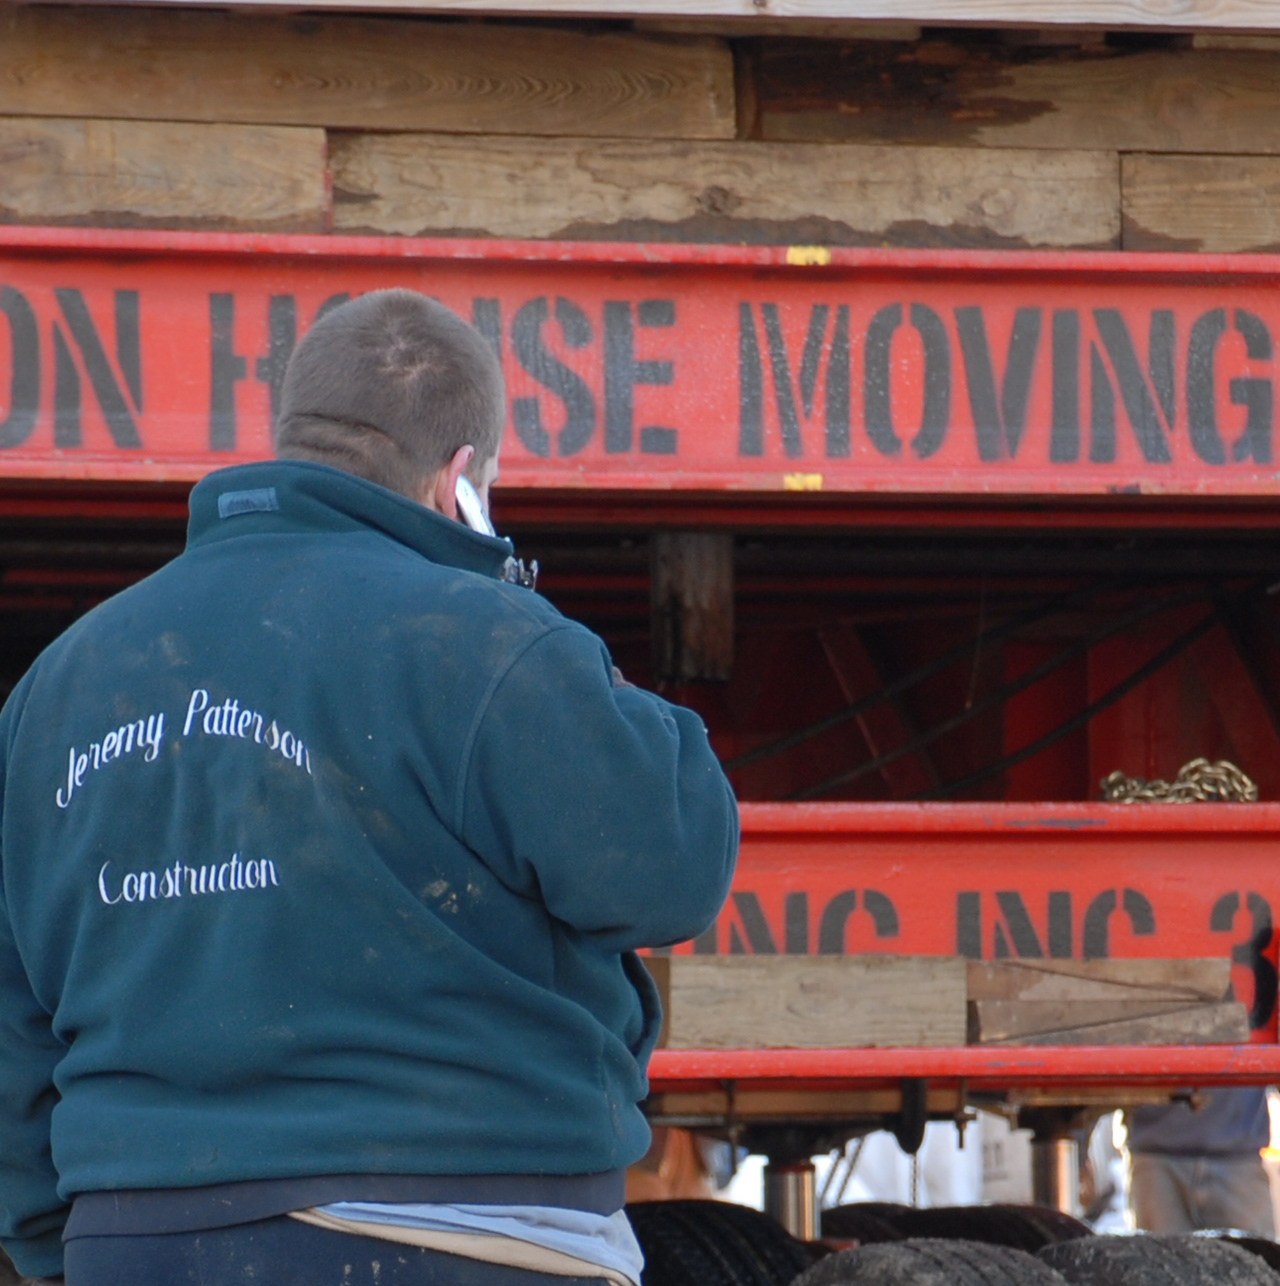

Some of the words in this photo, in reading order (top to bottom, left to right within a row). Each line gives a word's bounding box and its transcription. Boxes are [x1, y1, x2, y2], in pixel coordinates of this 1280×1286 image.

[208, 292, 678, 458] HSE
[737, 301, 1274, 466] MOVING
[56, 713, 164, 808] Jeremy
[183, 689, 312, 775] Patterson
[98, 853, 280, 904] Construction
